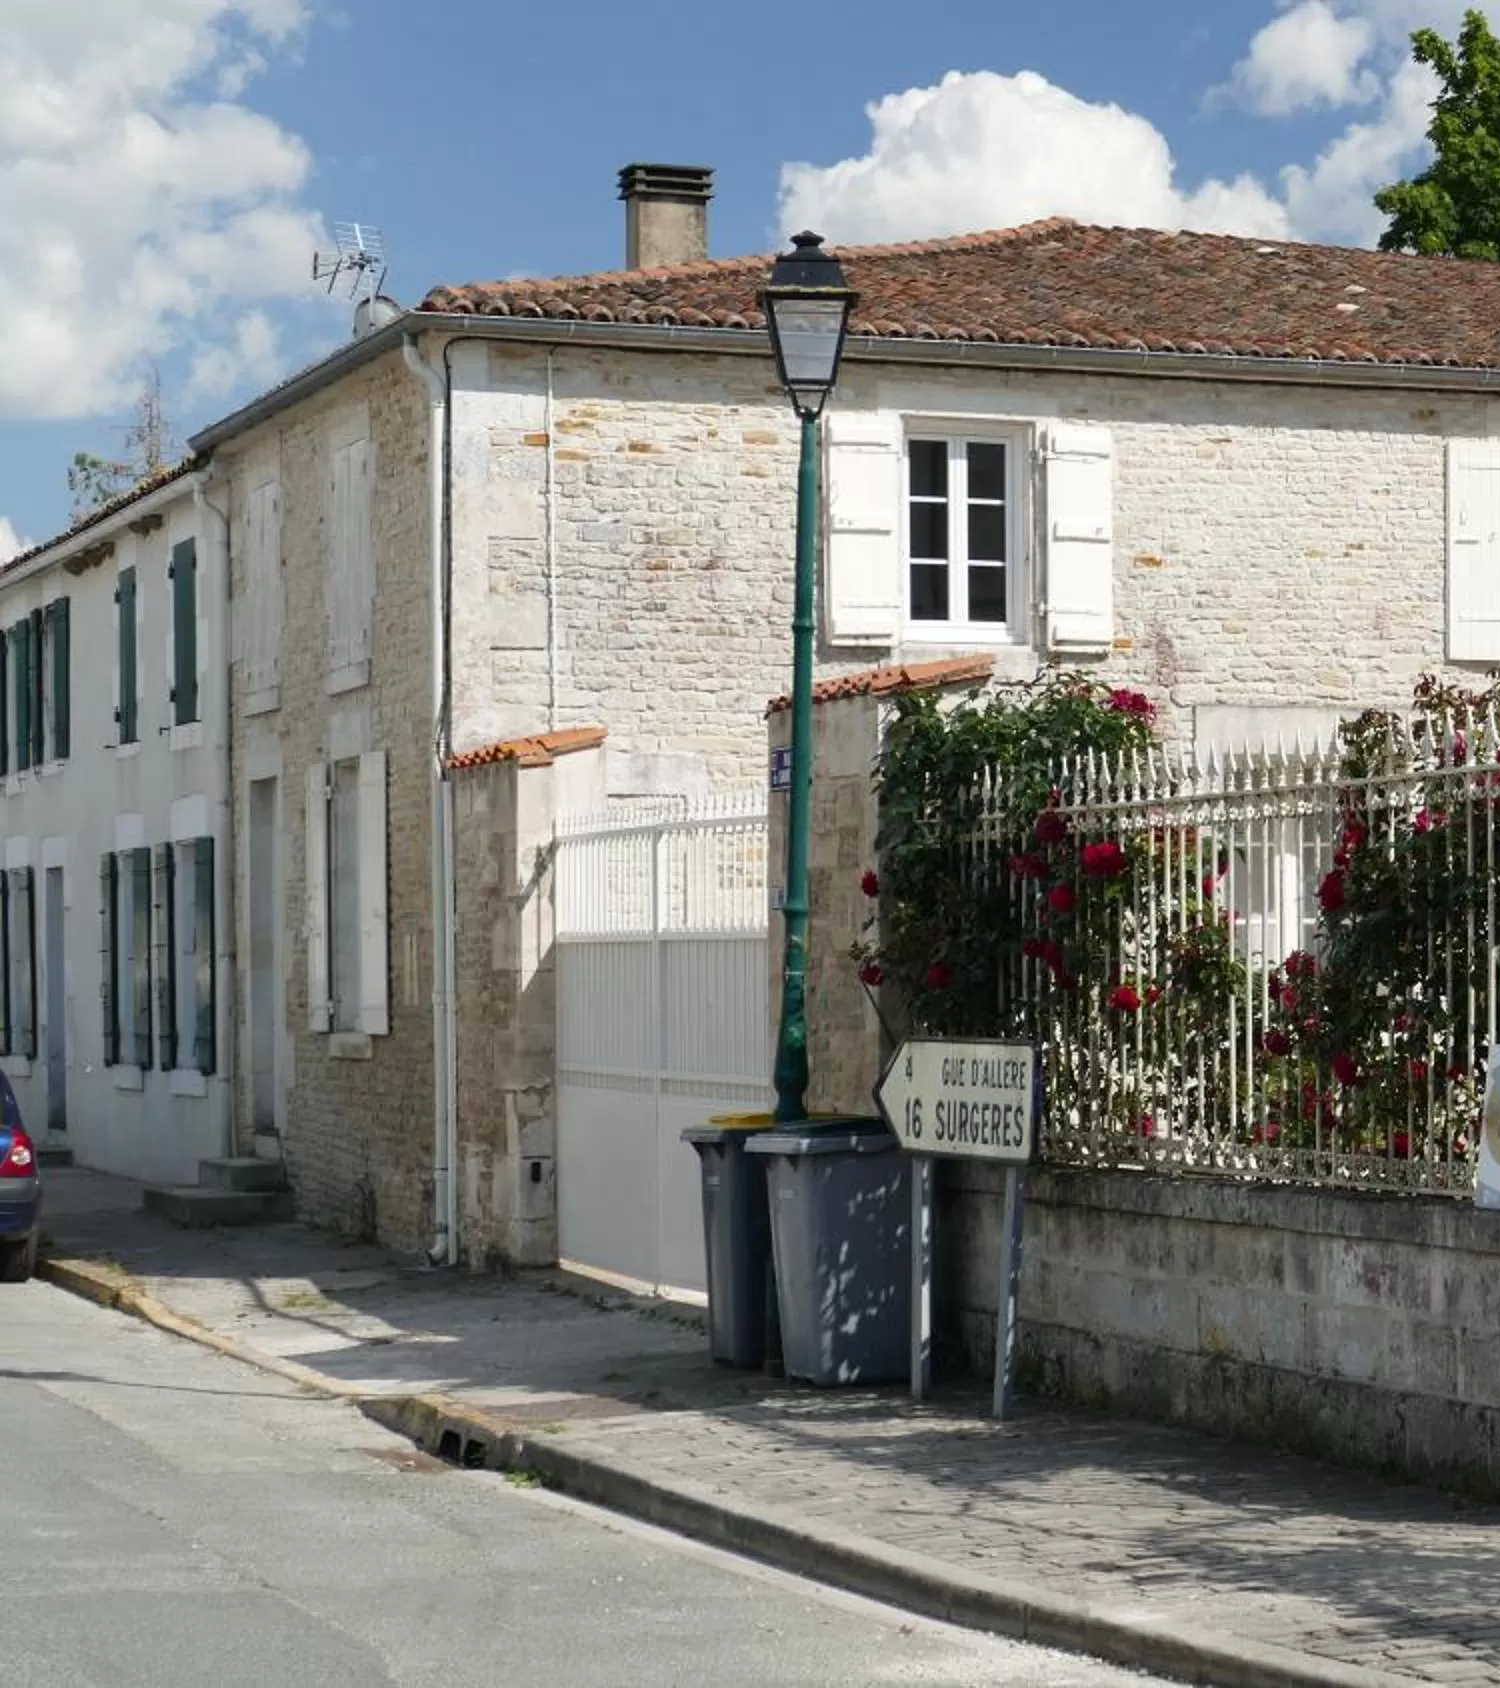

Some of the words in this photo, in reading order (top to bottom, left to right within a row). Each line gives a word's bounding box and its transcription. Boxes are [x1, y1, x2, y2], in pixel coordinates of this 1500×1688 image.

[942, 1058, 965, 1086] GUE
[905, 1097, 922, 1139] 16
[935, 1099, 1024, 1147] SURGERES
